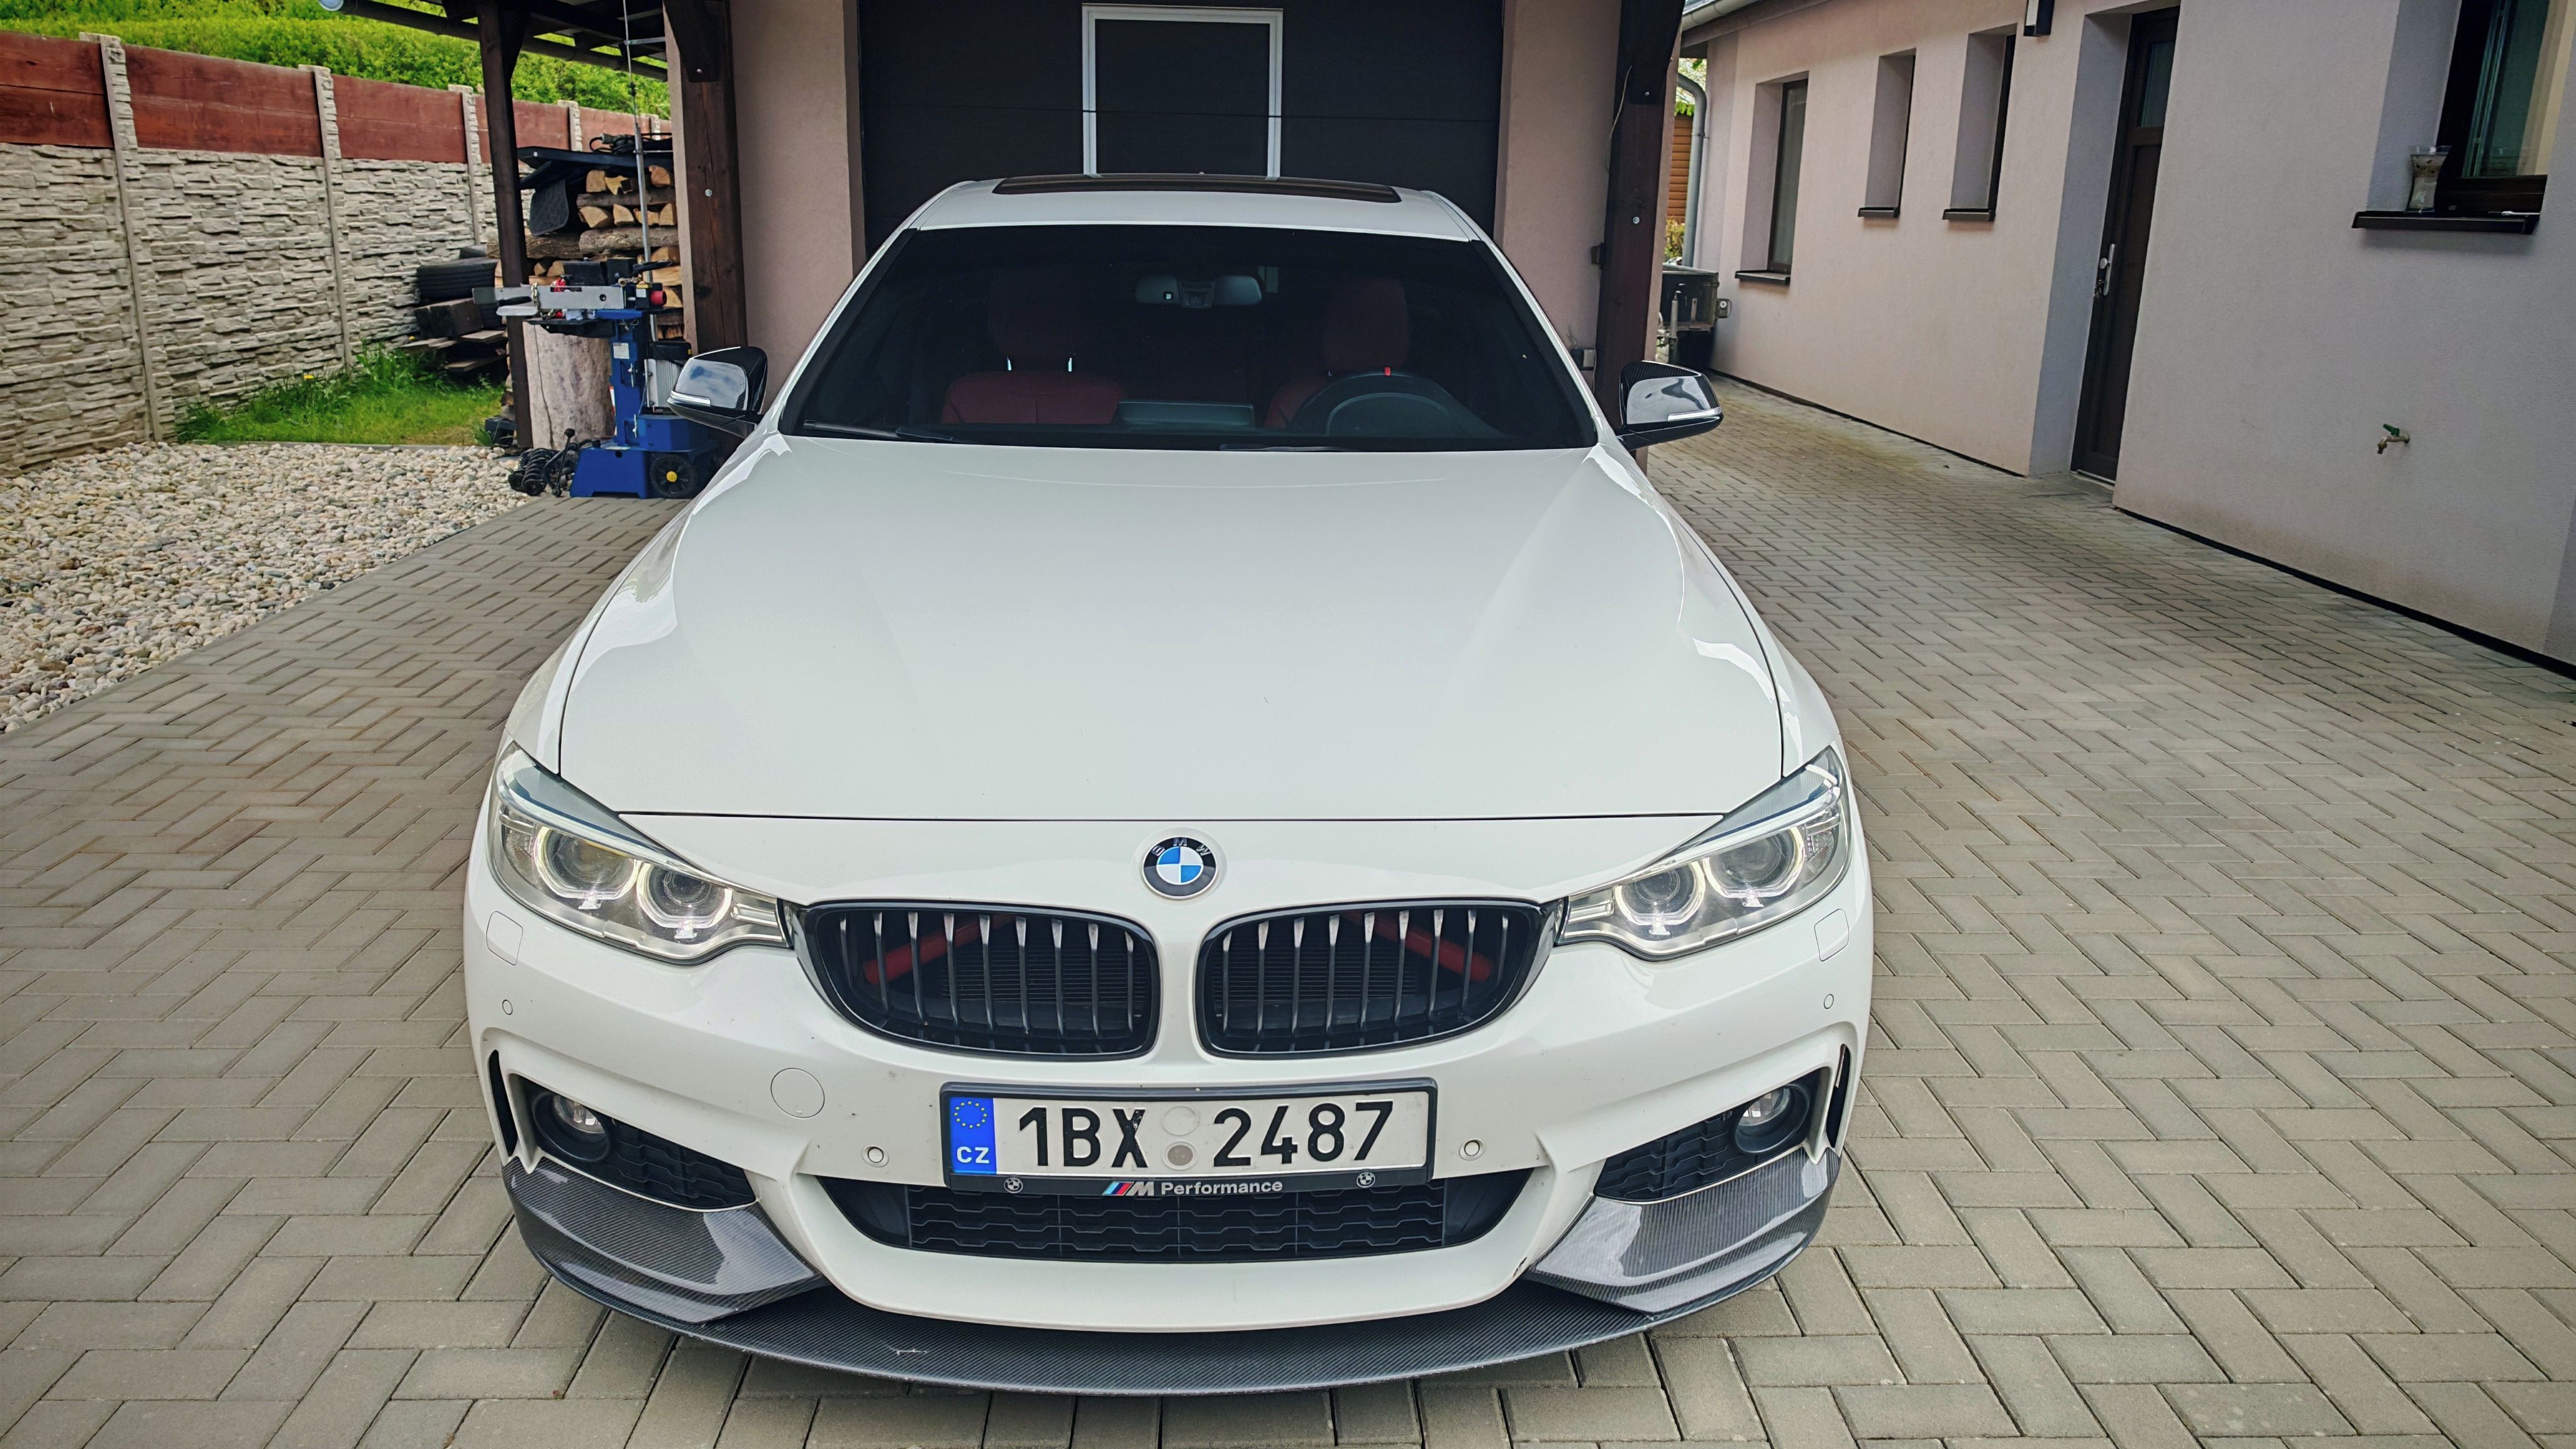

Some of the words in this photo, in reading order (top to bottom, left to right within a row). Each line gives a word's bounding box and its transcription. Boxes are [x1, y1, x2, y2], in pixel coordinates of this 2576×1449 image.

[1151, 837, 1212, 857] BMW
[1019, 1106, 1148, 1168] 1BX
[1213, 1101, 1394, 1167] 2487
[956, 1146, 990, 1163] CZ
[1161, 1180, 1284, 1196] Performance
